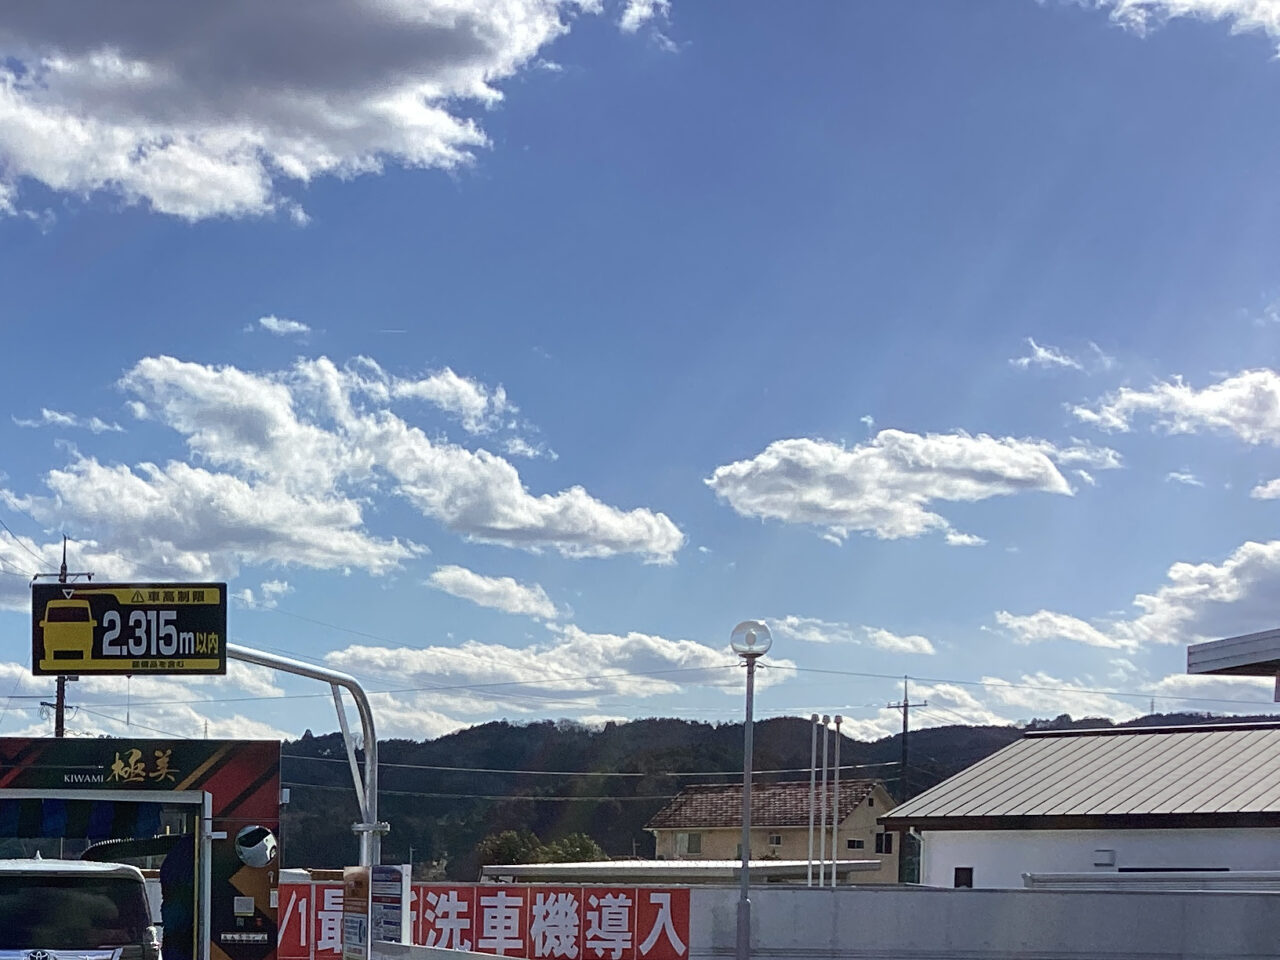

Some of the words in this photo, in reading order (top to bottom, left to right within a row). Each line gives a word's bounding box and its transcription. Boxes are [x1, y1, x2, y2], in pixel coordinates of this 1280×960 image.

[147, 590, 205, 602] 車高制限
[64, 774, 104, 783] KIWAMI
